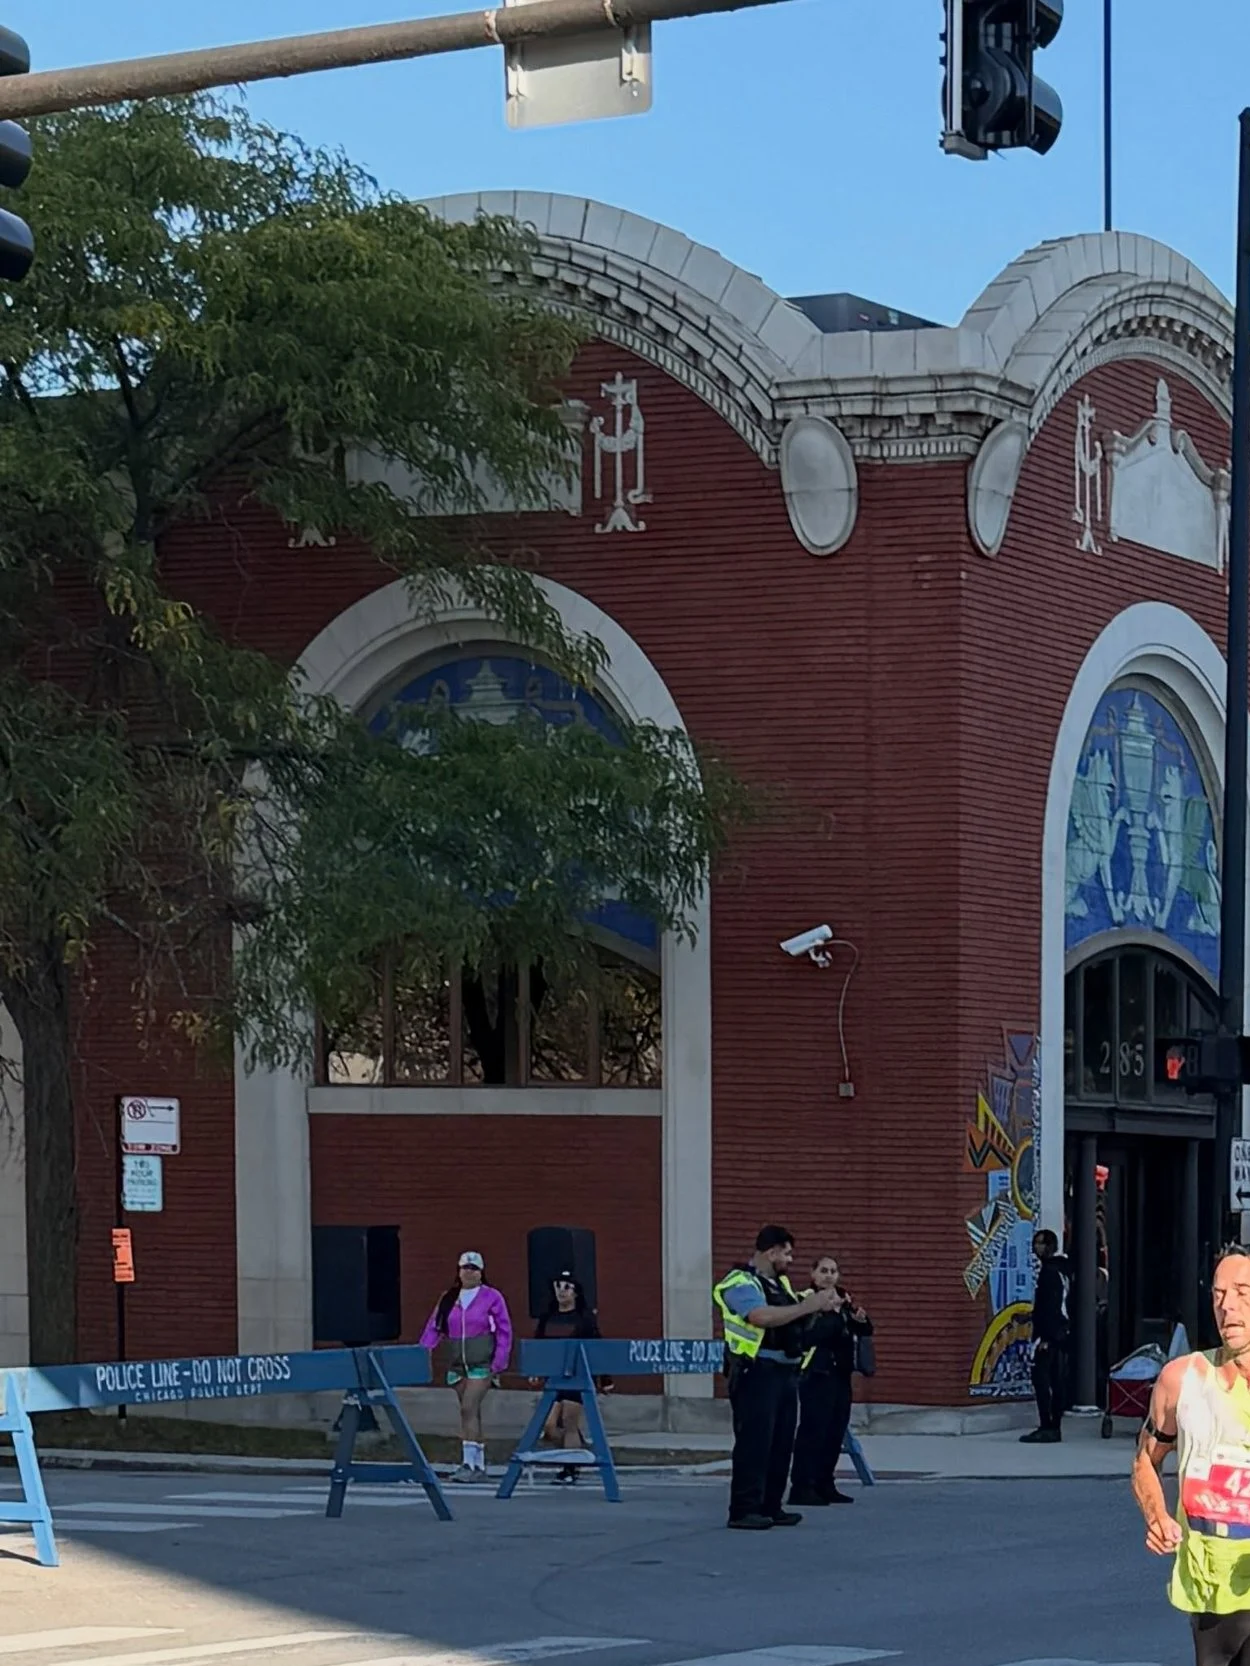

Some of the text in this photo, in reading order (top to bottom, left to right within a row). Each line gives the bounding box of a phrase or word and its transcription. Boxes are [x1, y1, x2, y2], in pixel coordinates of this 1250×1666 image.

[629, 1340, 661, 1362] POLICE
[96, 1363, 146, 1392] POLICE
[217, 1357, 242, 1384] NOT
[247, 1355, 291, 1381] CROSS
[135, 1383, 262, 1402] CHICAGO POLICE DEPT
